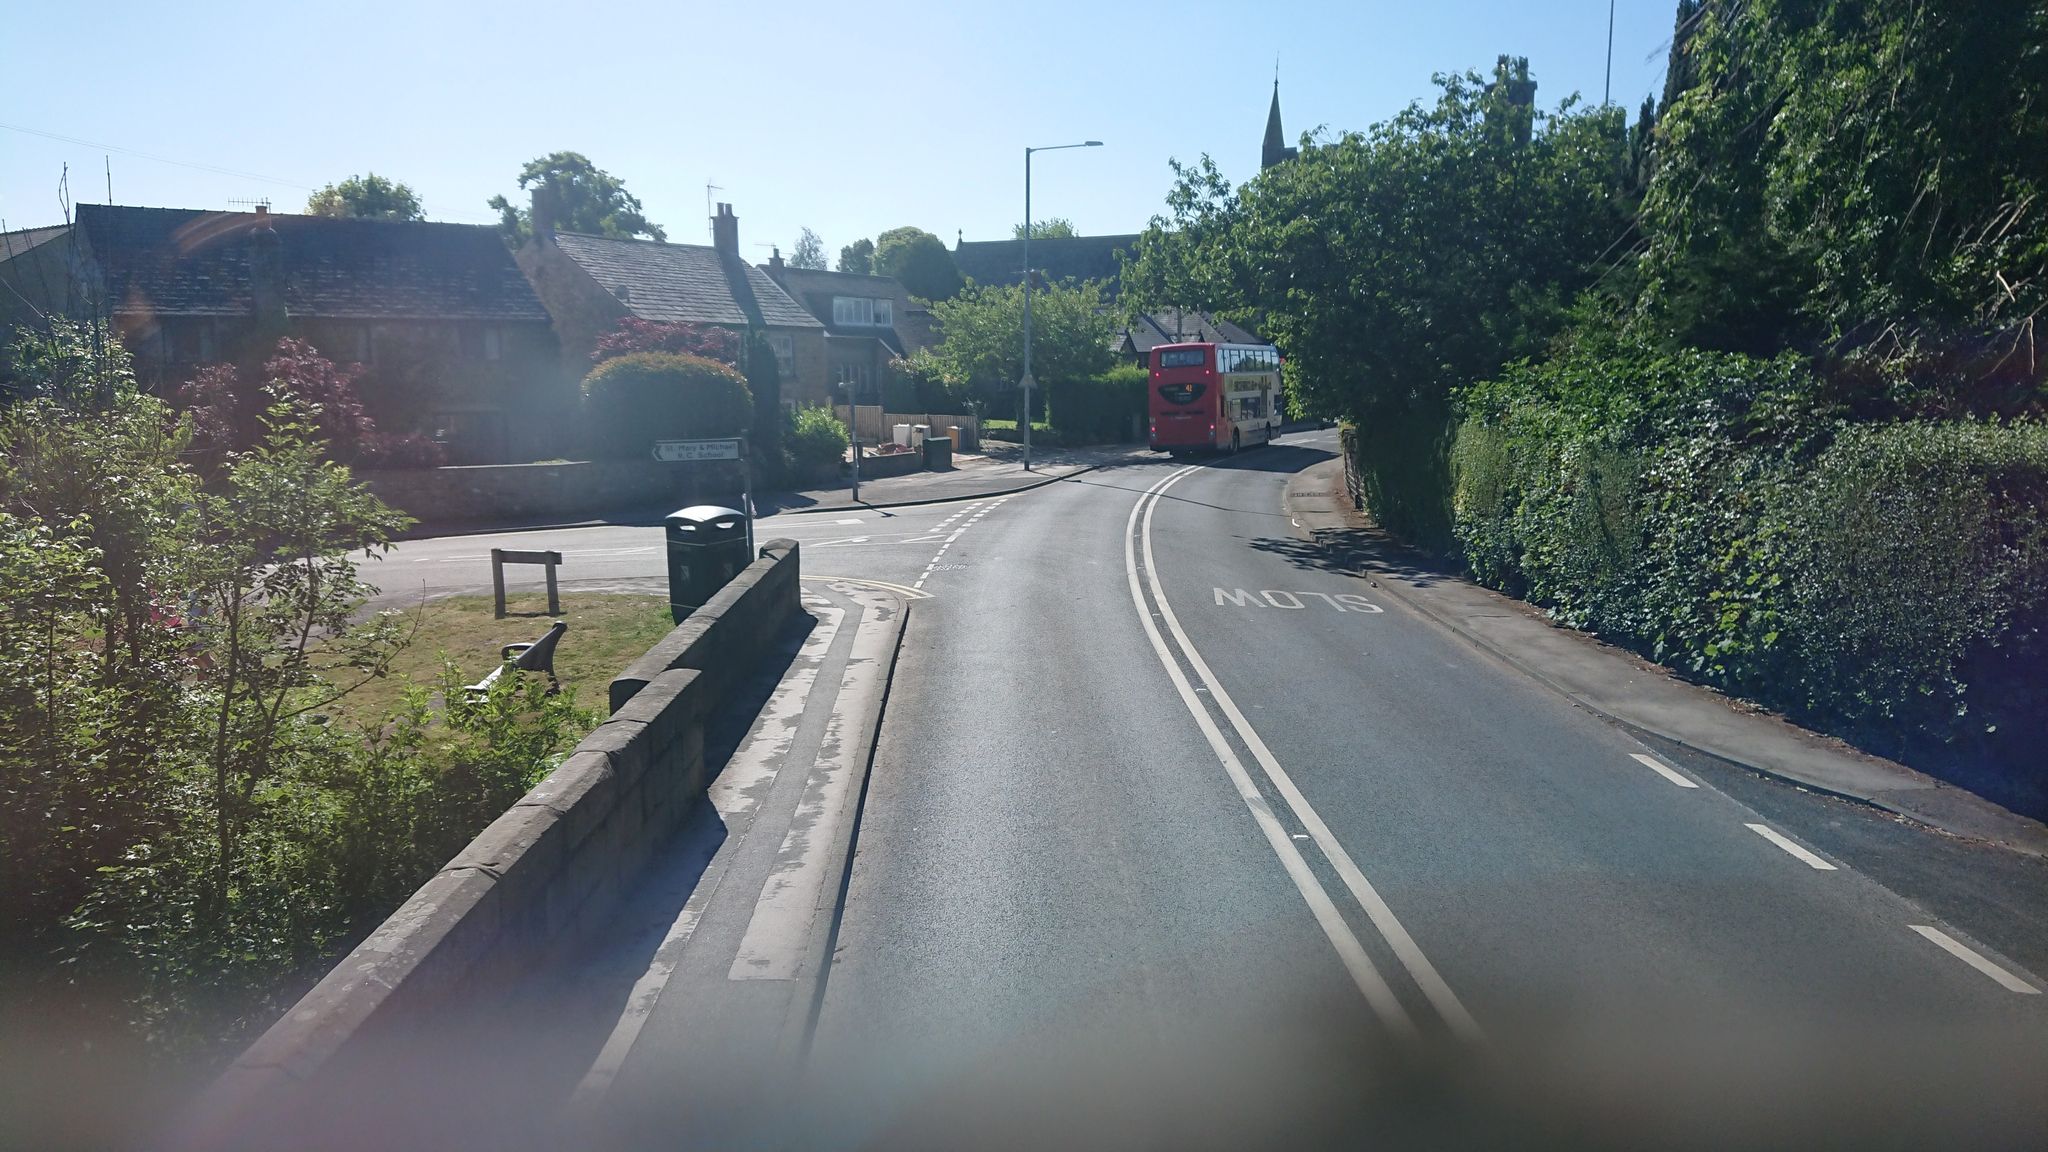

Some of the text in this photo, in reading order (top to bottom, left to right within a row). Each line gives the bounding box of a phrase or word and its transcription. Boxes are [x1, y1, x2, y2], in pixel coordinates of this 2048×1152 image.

[678, 444, 696, 452] Mary
[699, 443, 705, 451] &
[1212, 586, 1385, 614] SLOW
